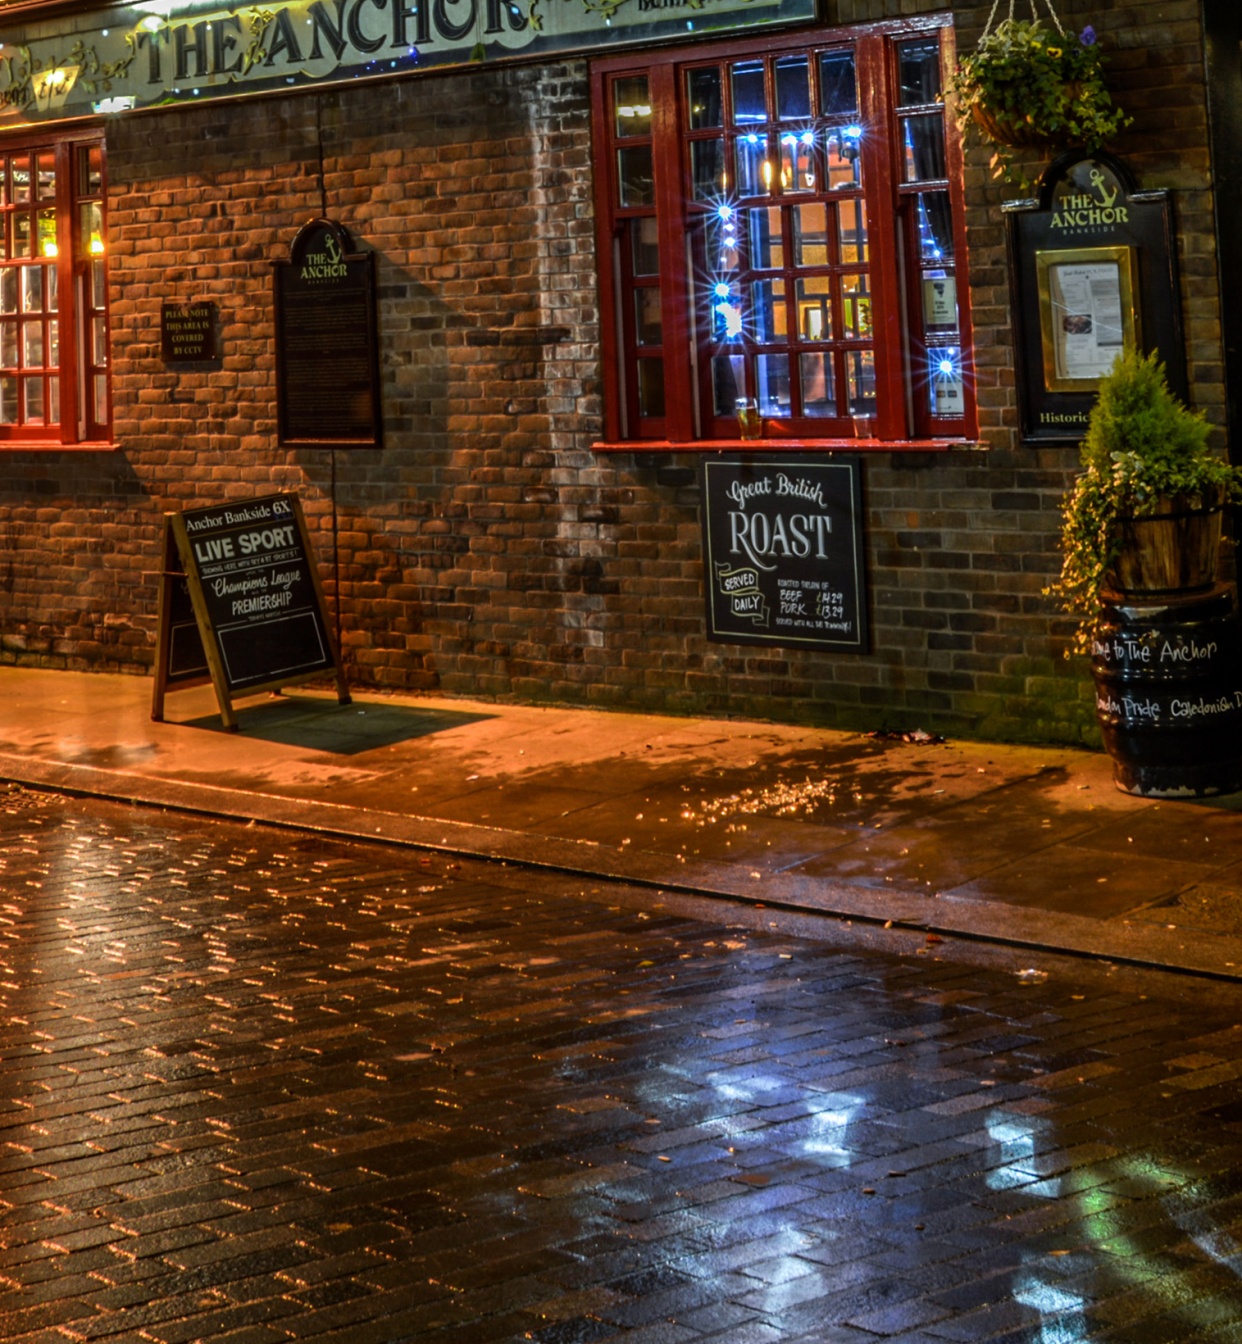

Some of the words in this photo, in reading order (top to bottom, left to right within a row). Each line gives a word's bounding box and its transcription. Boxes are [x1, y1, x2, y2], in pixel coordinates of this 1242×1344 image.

[140, 14, 244, 84] THE
[1059, 194, 1093, 210] THE
[1050, 207, 1129, 228] ANCHOR
[1063, 225, 1115, 235] BANKSIDE
[306, 253, 327, 265] THE
[300, 263, 348, 279] ANCHOR
[190, 308, 209, 317] NOTE
[166, 322, 182, 331] THIS
[183, 321, 201, 330] AREA
[202, 320, 210, 329] IS
[171, 333, 204, 343] COVERED
[174, 346, 182, 355] BY
[183, 345, 202, 355] CCTV
[1040, 411, 1090, 423] Historic
[726, 476, 772, 510] Great
[775, 472, 828, 509] British
[186, 516, 223, 532] Anchor
[224, 505, 271, 525] Bankside
[272, 500, 291, 514] 6X
[195, 537, 235, 563] LIVE
[238, 525, 294, 554] SPORT
[727, 511, 832, 571] ROAST
[211, 576, 268, 597] Champions
[271, 569, 301, 590] League
[724, 573, 755, 590] SERVED
[232, 591, 293, 616] PREMIERSHIP
[734, 596, 761, 611] DAILY
[779, 589, 803, 602] BEEF
[780, 601, 807, 615] PORK
[1113, 640, 1125, 659] to
[1124, 640, 1150, 663] The
[1160, 640, 1217, 662] Anchor
[1121, 697, 1161, 718] Pride
